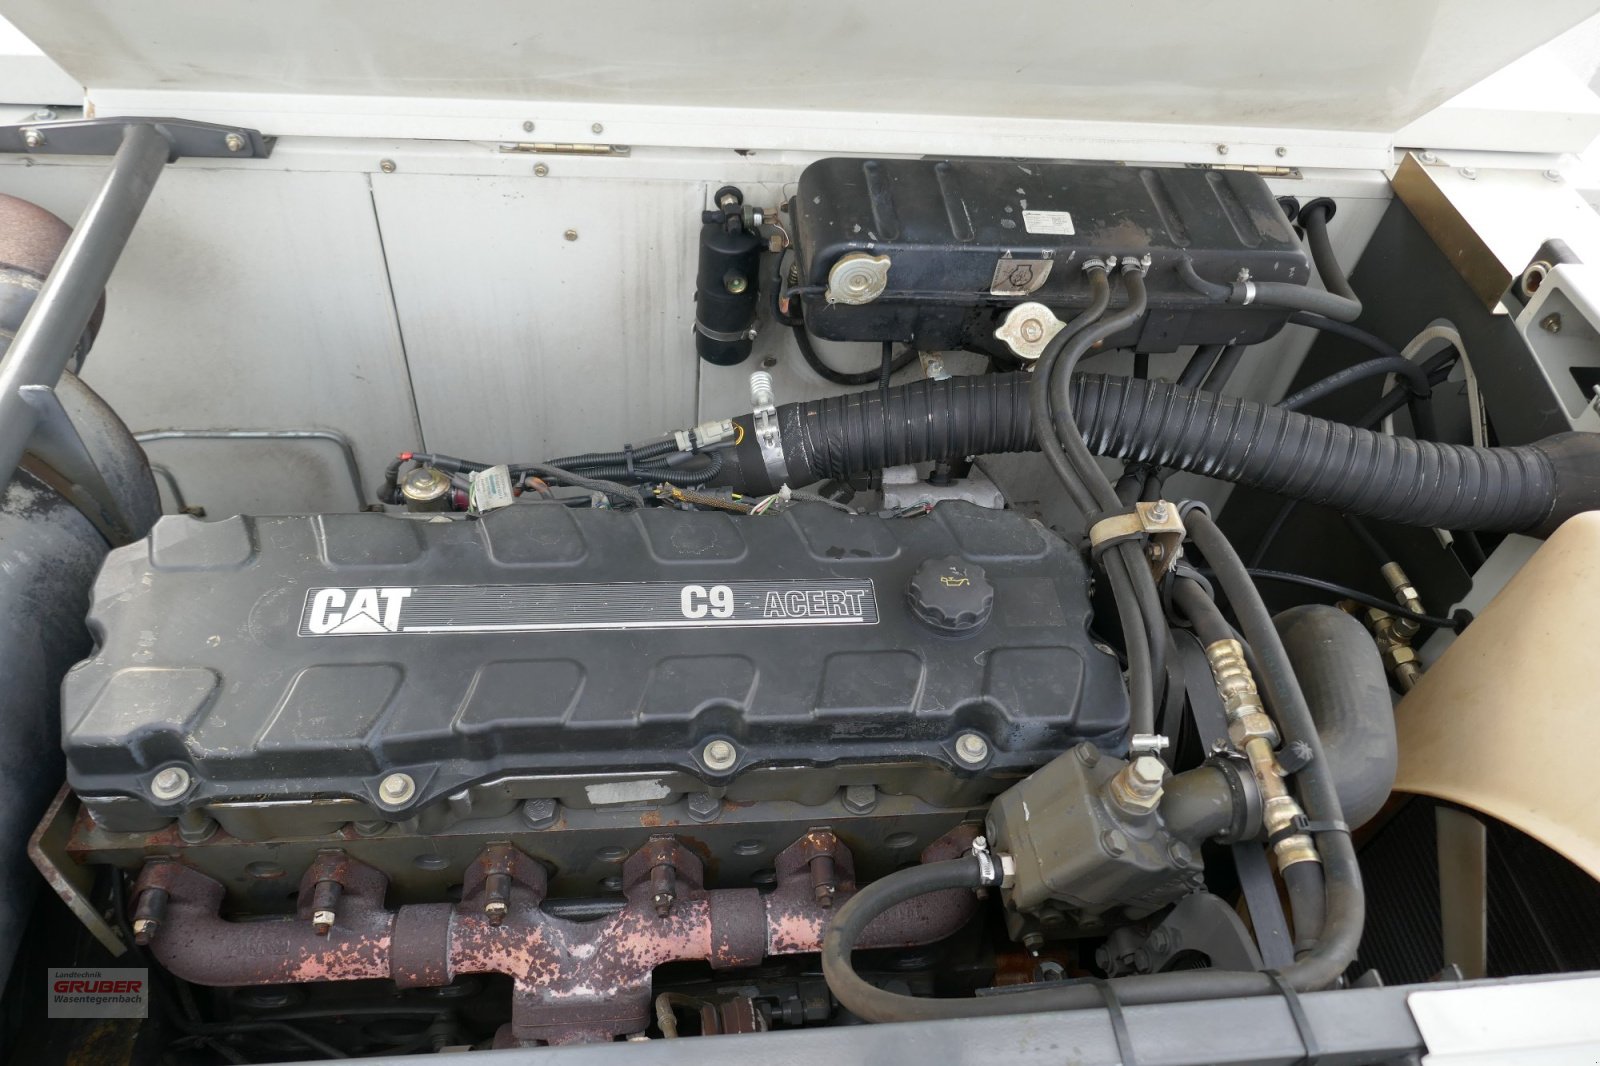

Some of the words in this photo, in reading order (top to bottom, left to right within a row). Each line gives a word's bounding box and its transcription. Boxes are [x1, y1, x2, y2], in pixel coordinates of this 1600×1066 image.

[309, 588, 411, 633] CAT
[681, 585, 735, 618] C9
[763, 590, 865, 617] ACERT
